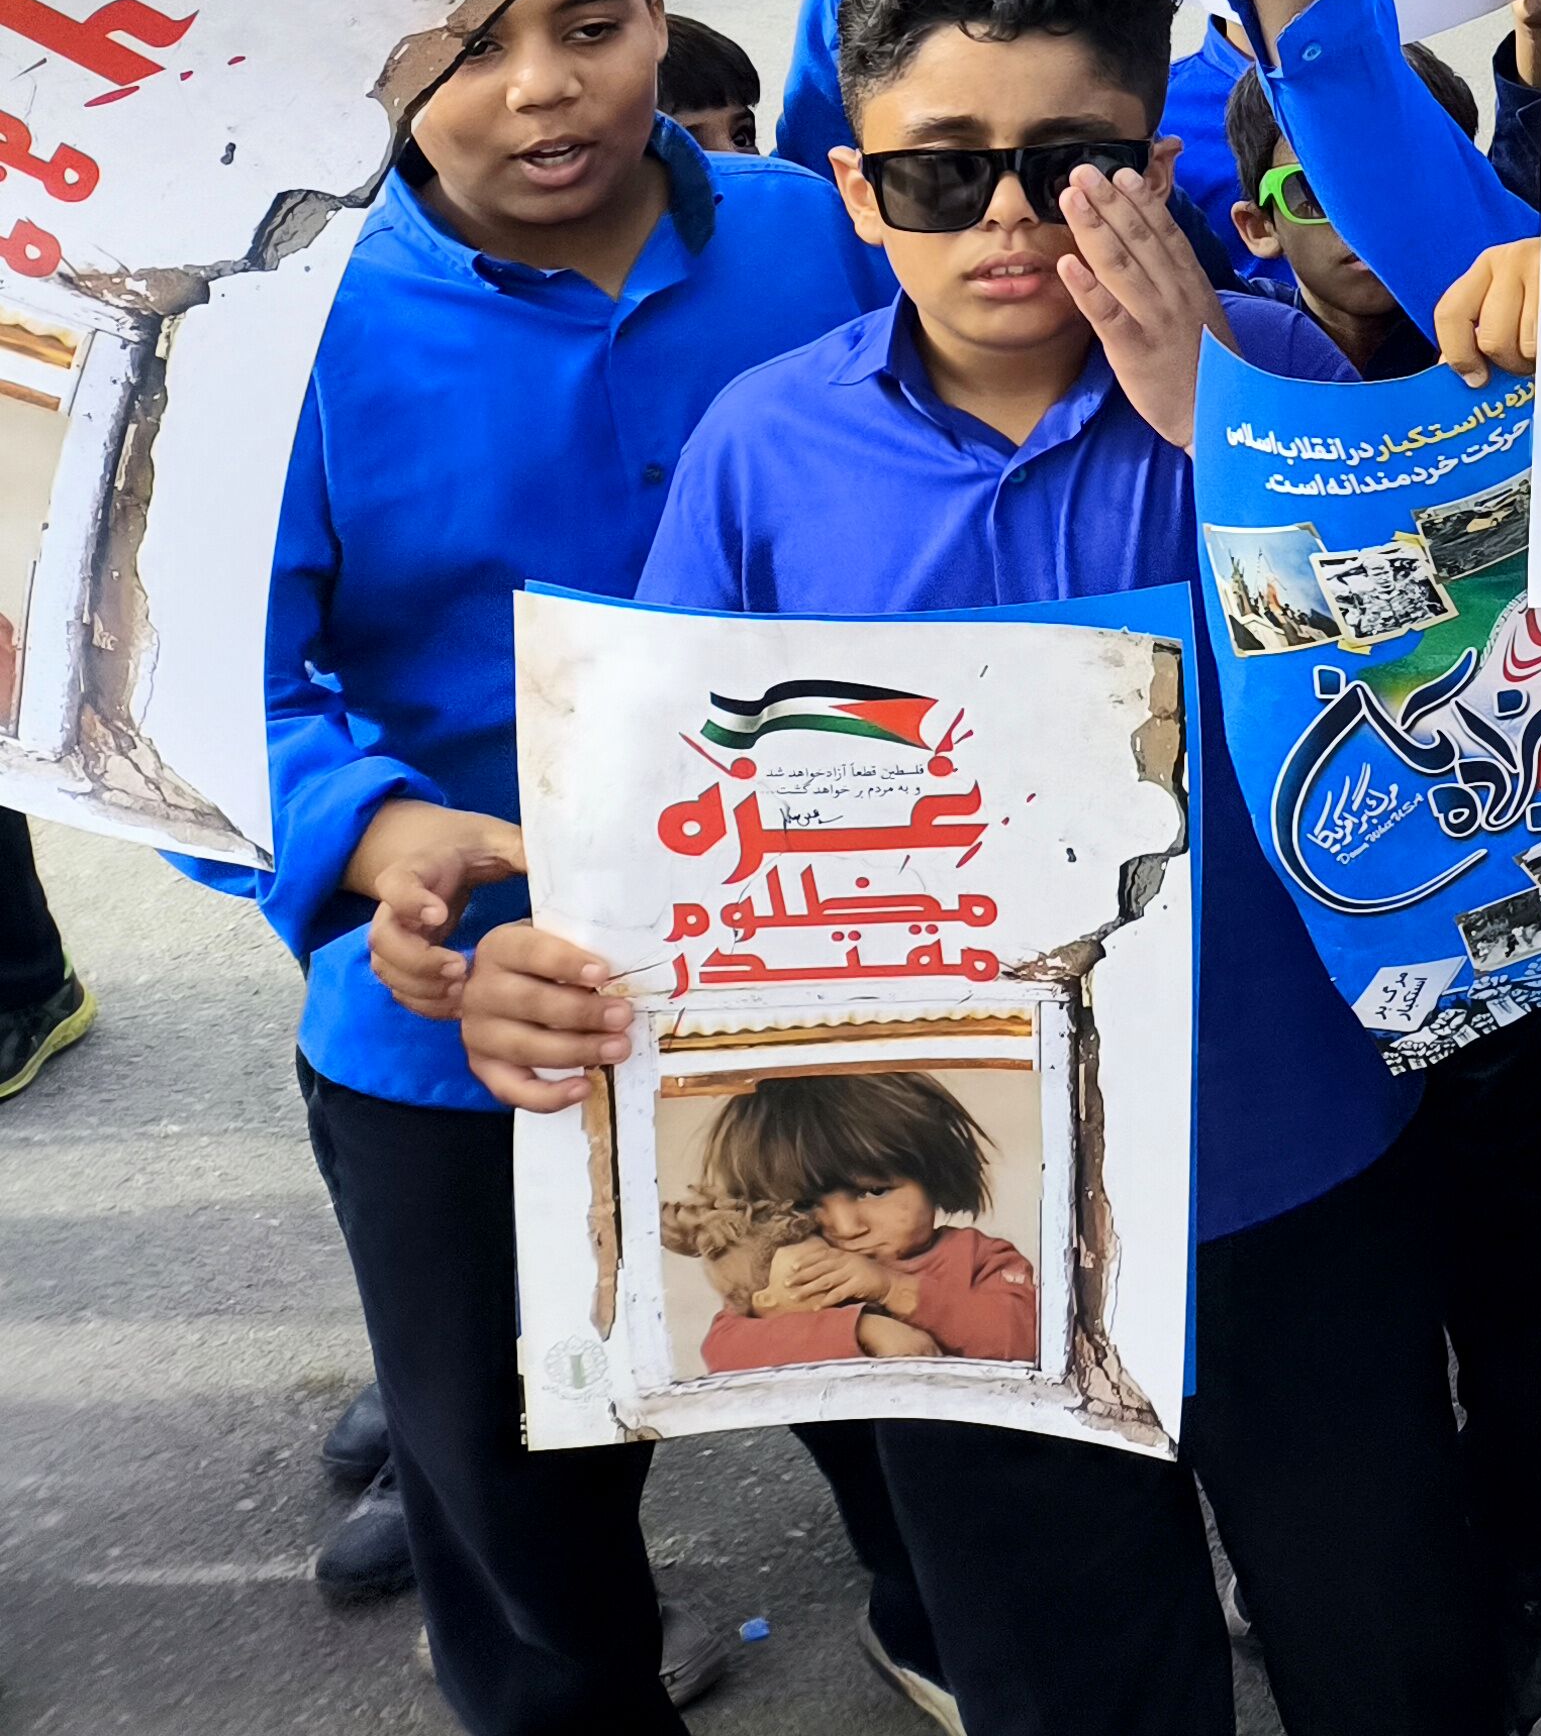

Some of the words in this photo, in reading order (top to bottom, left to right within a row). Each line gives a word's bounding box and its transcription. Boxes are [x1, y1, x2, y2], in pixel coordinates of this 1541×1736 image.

[1375, 405, 1486, 463] استکبار
[1460, 418, 1531, 465] حرکت
[1345, 441, 1375, 466] در
[1327, 455, 1459, 497] خردمندانه
[766, 765, 785, 778] شد
[788, 767, 825, 781] خواهد
[825, 763, 847, 782] آزاد
[880, 764, 925, 780] فلسطین
[812, 783, 850, 799] خواهد
[867, 784, 894, 799] مردم
[899, 783, 909, 795] به
[913, 786, 921, 796] و
[657, 752, 989, 886] غزه
[663, 864, 999, 942] مظلوم
[668, 920, 1000, 1000] مقتدر
